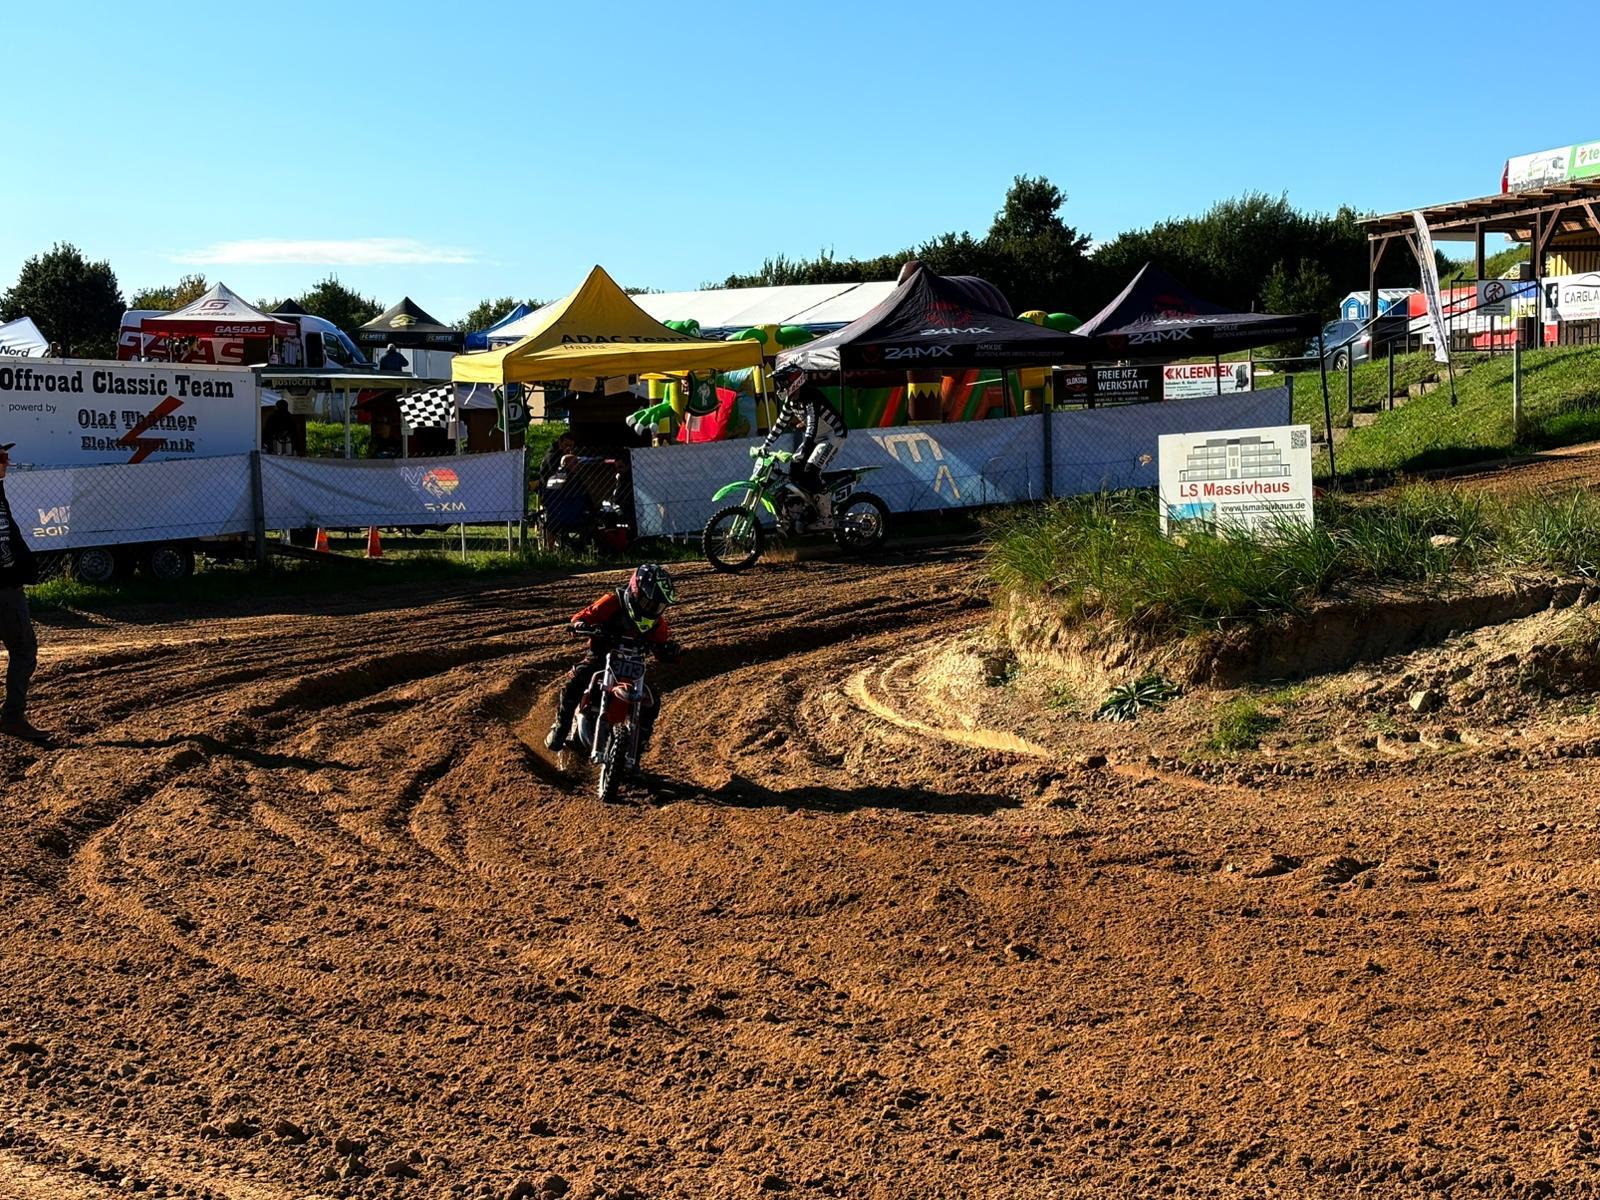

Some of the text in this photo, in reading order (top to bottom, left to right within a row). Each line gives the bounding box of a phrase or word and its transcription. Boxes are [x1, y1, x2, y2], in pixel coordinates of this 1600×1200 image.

[1153, 318, 1221, 326] 24MX
[215, 326, 266, 334] GASGAS
[920, 327, 994, 336] 24MX
[561, 334, 625, 344] ADAC
[1128, 328, 1194, 345] 24MX
[0, 346, 31, 357] Nord
[885, 345, 953, 360] 24MX
[1097, 369, 1138, 380] FREIE KFZ
[1175, 365, 1234, 379] KLEENTEK
[0, 367, 234, 398] Offroad Classic Team
[1097, 380, 1149, 391] WERKSTATT
[9, 403, 57, 414] powerd by
[78, 409, 117, 429] Olaf
[1180, 480, 1290, 497] LS Massivhaus
